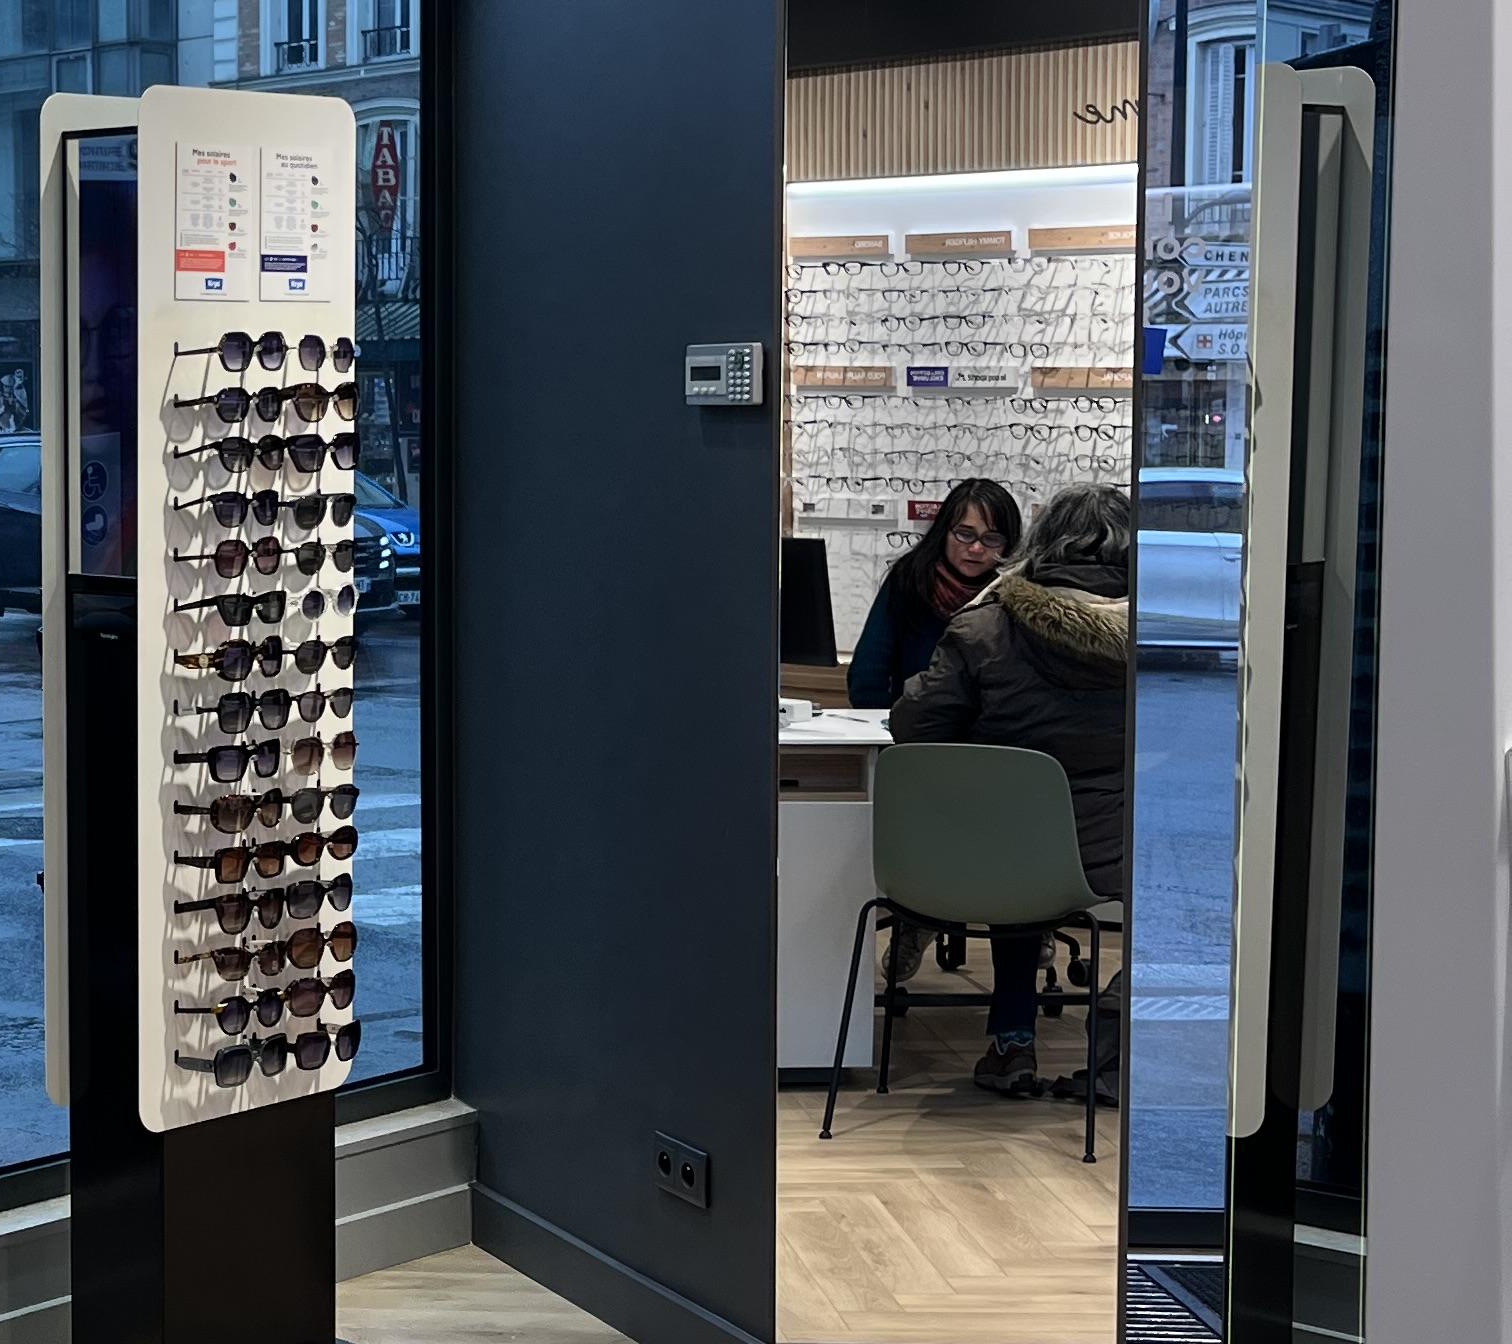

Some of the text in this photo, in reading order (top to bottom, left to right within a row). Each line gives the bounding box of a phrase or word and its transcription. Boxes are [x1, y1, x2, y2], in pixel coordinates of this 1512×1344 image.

[192, 148, 205, 157] Mes
[276, 153, 313, 162] Mes solaires
[290, 162, 319, 170] quotidien
[374, 126, 397, 228] TABAC
[1204, 249, 1249, 262] CHEN
[1203, 286, 1249, 299] PARCS
[1203, 300, 1247, 314] AUTRE
